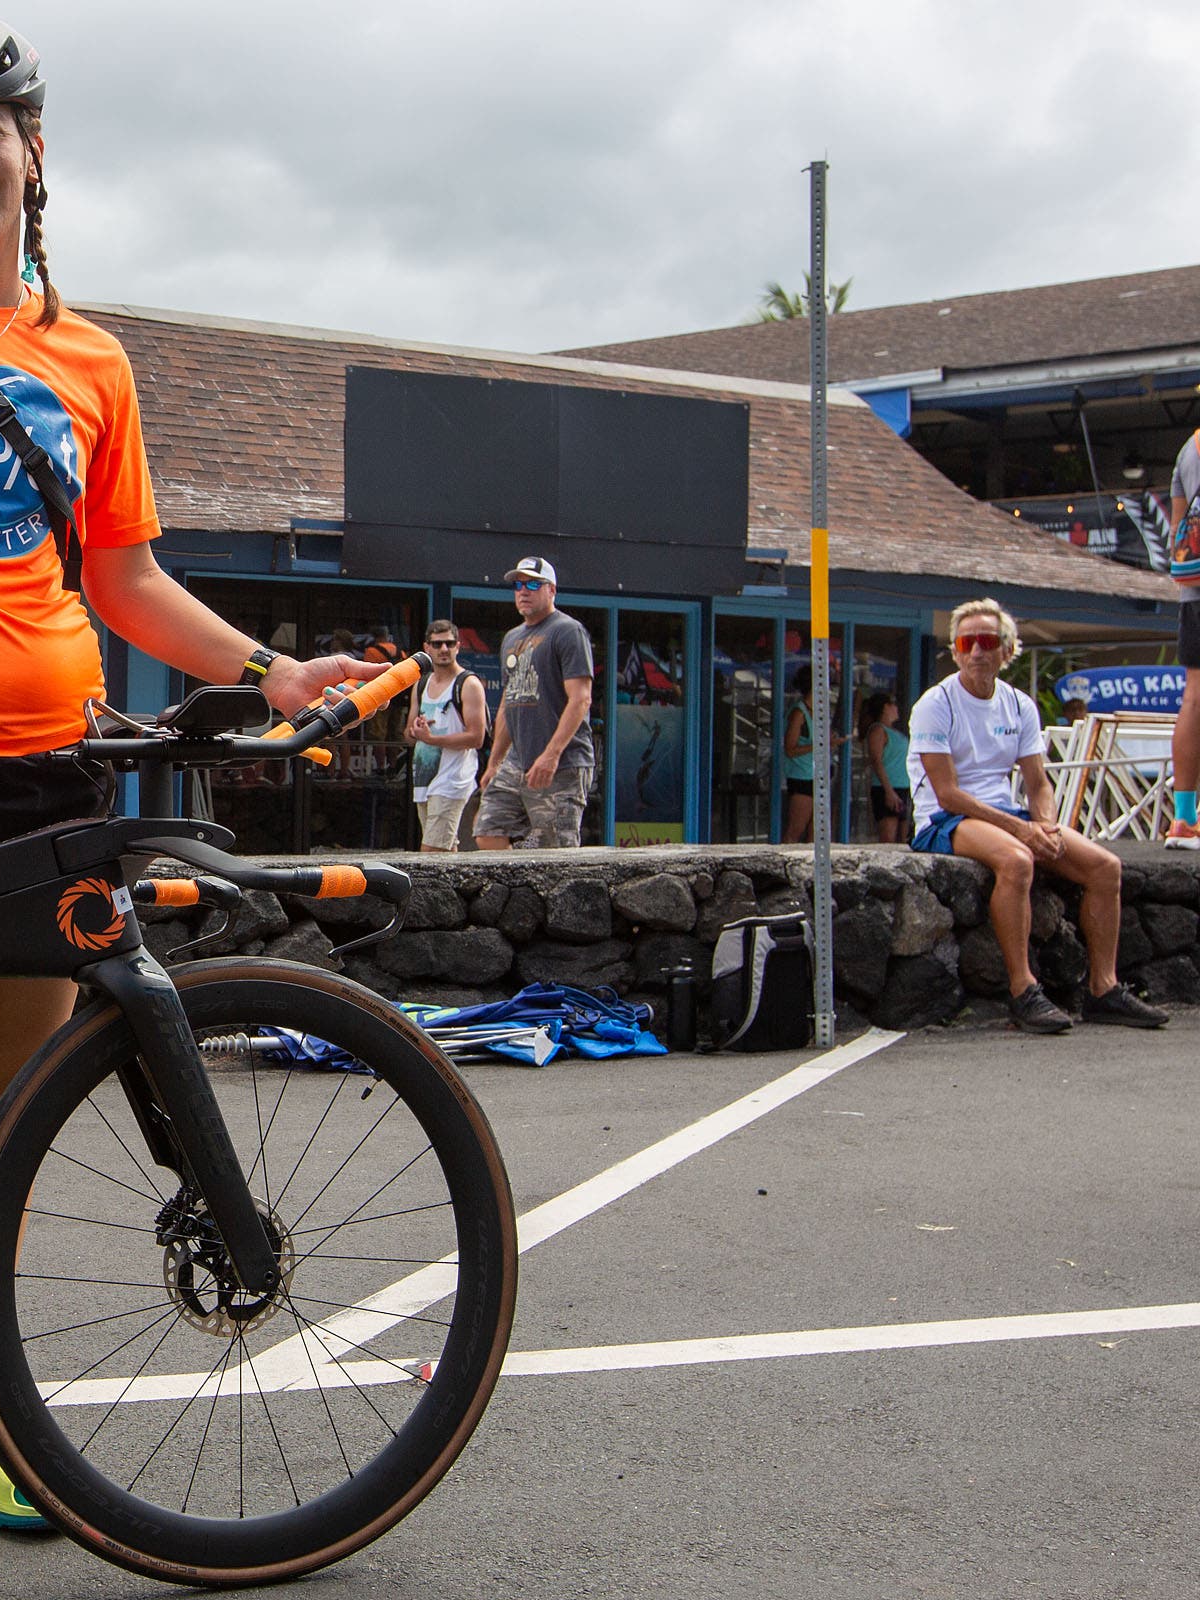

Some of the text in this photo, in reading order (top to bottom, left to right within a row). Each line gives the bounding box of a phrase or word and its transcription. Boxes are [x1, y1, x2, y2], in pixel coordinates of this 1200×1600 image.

[1098, 674, 1186, 699] BIG KAH
[1122, 697, 1168, 705] BEACH
